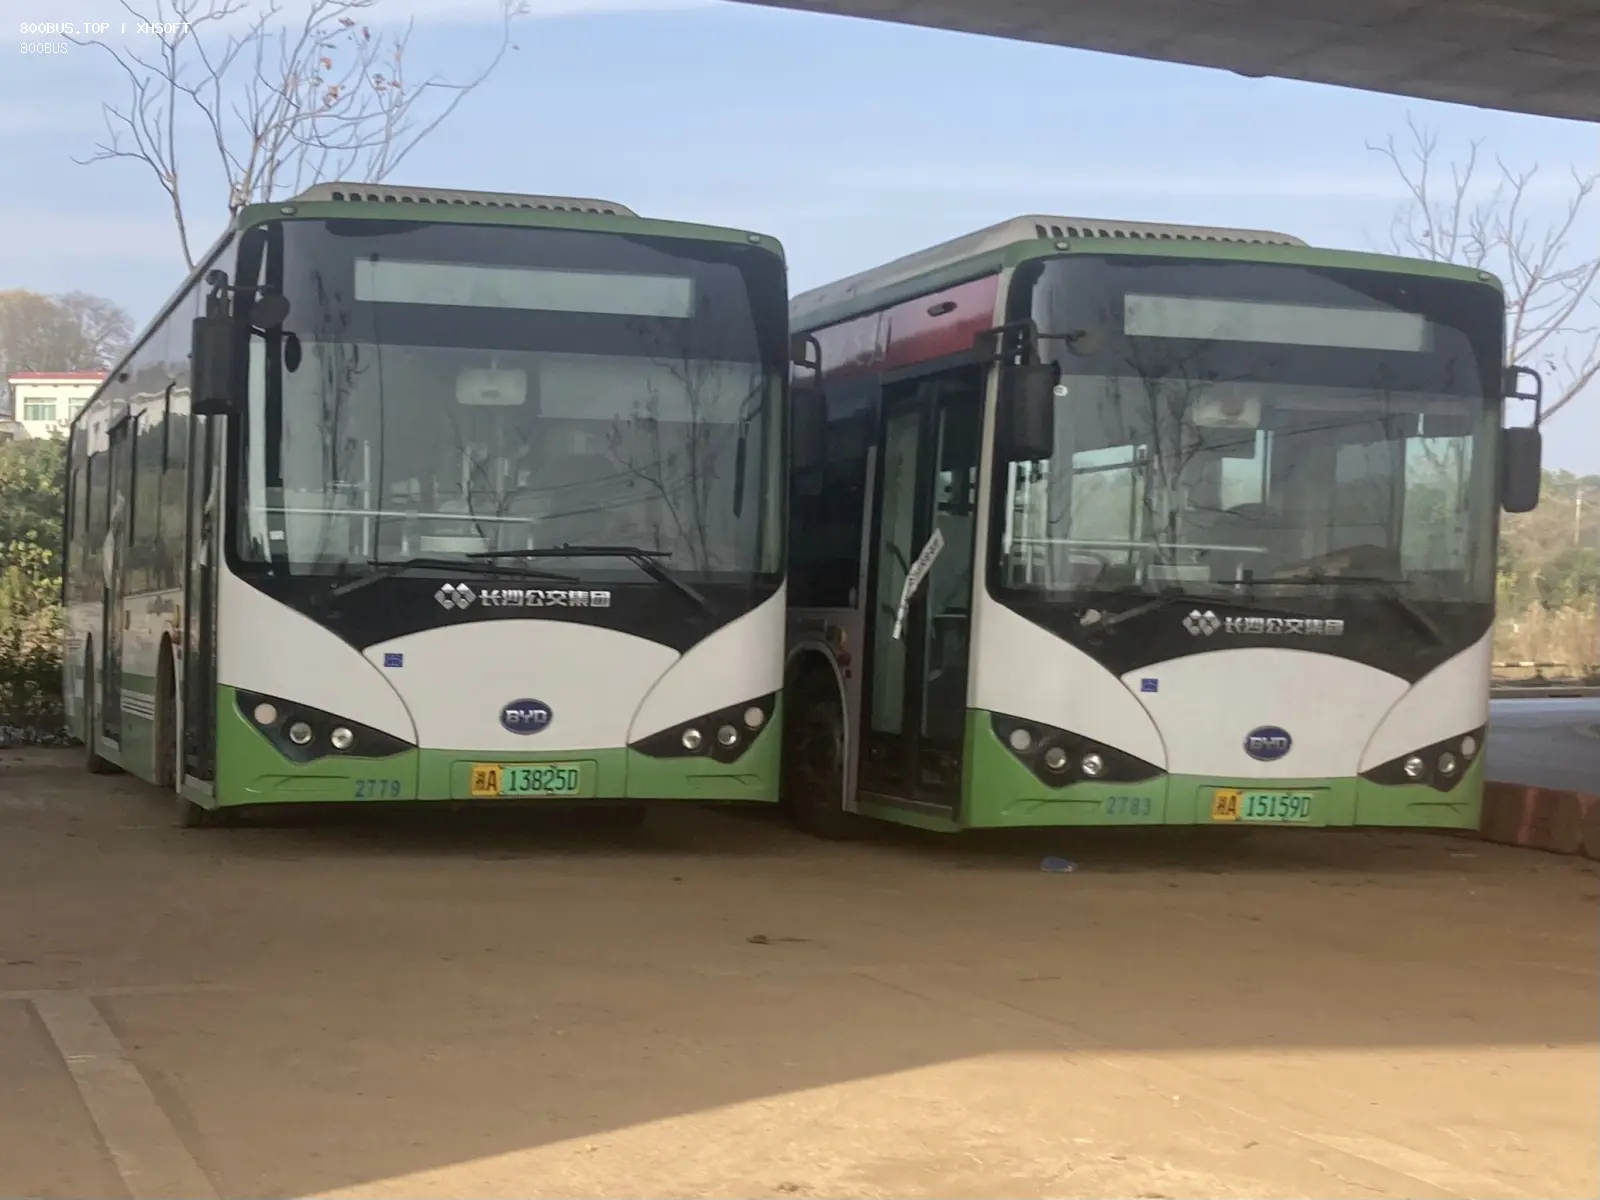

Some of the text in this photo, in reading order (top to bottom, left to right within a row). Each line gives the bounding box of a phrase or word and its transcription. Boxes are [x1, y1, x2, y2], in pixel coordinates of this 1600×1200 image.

[479, 589, 611, 608] 长沙公交集团
[505, 709, 548, 724] BYD
[1250, 736, 1288, 750] BYD
[355, 779, 401, 798] 2779
[508, 769, 579, 792] 13825D
[1246, 796, 1312, 818] 15159D
